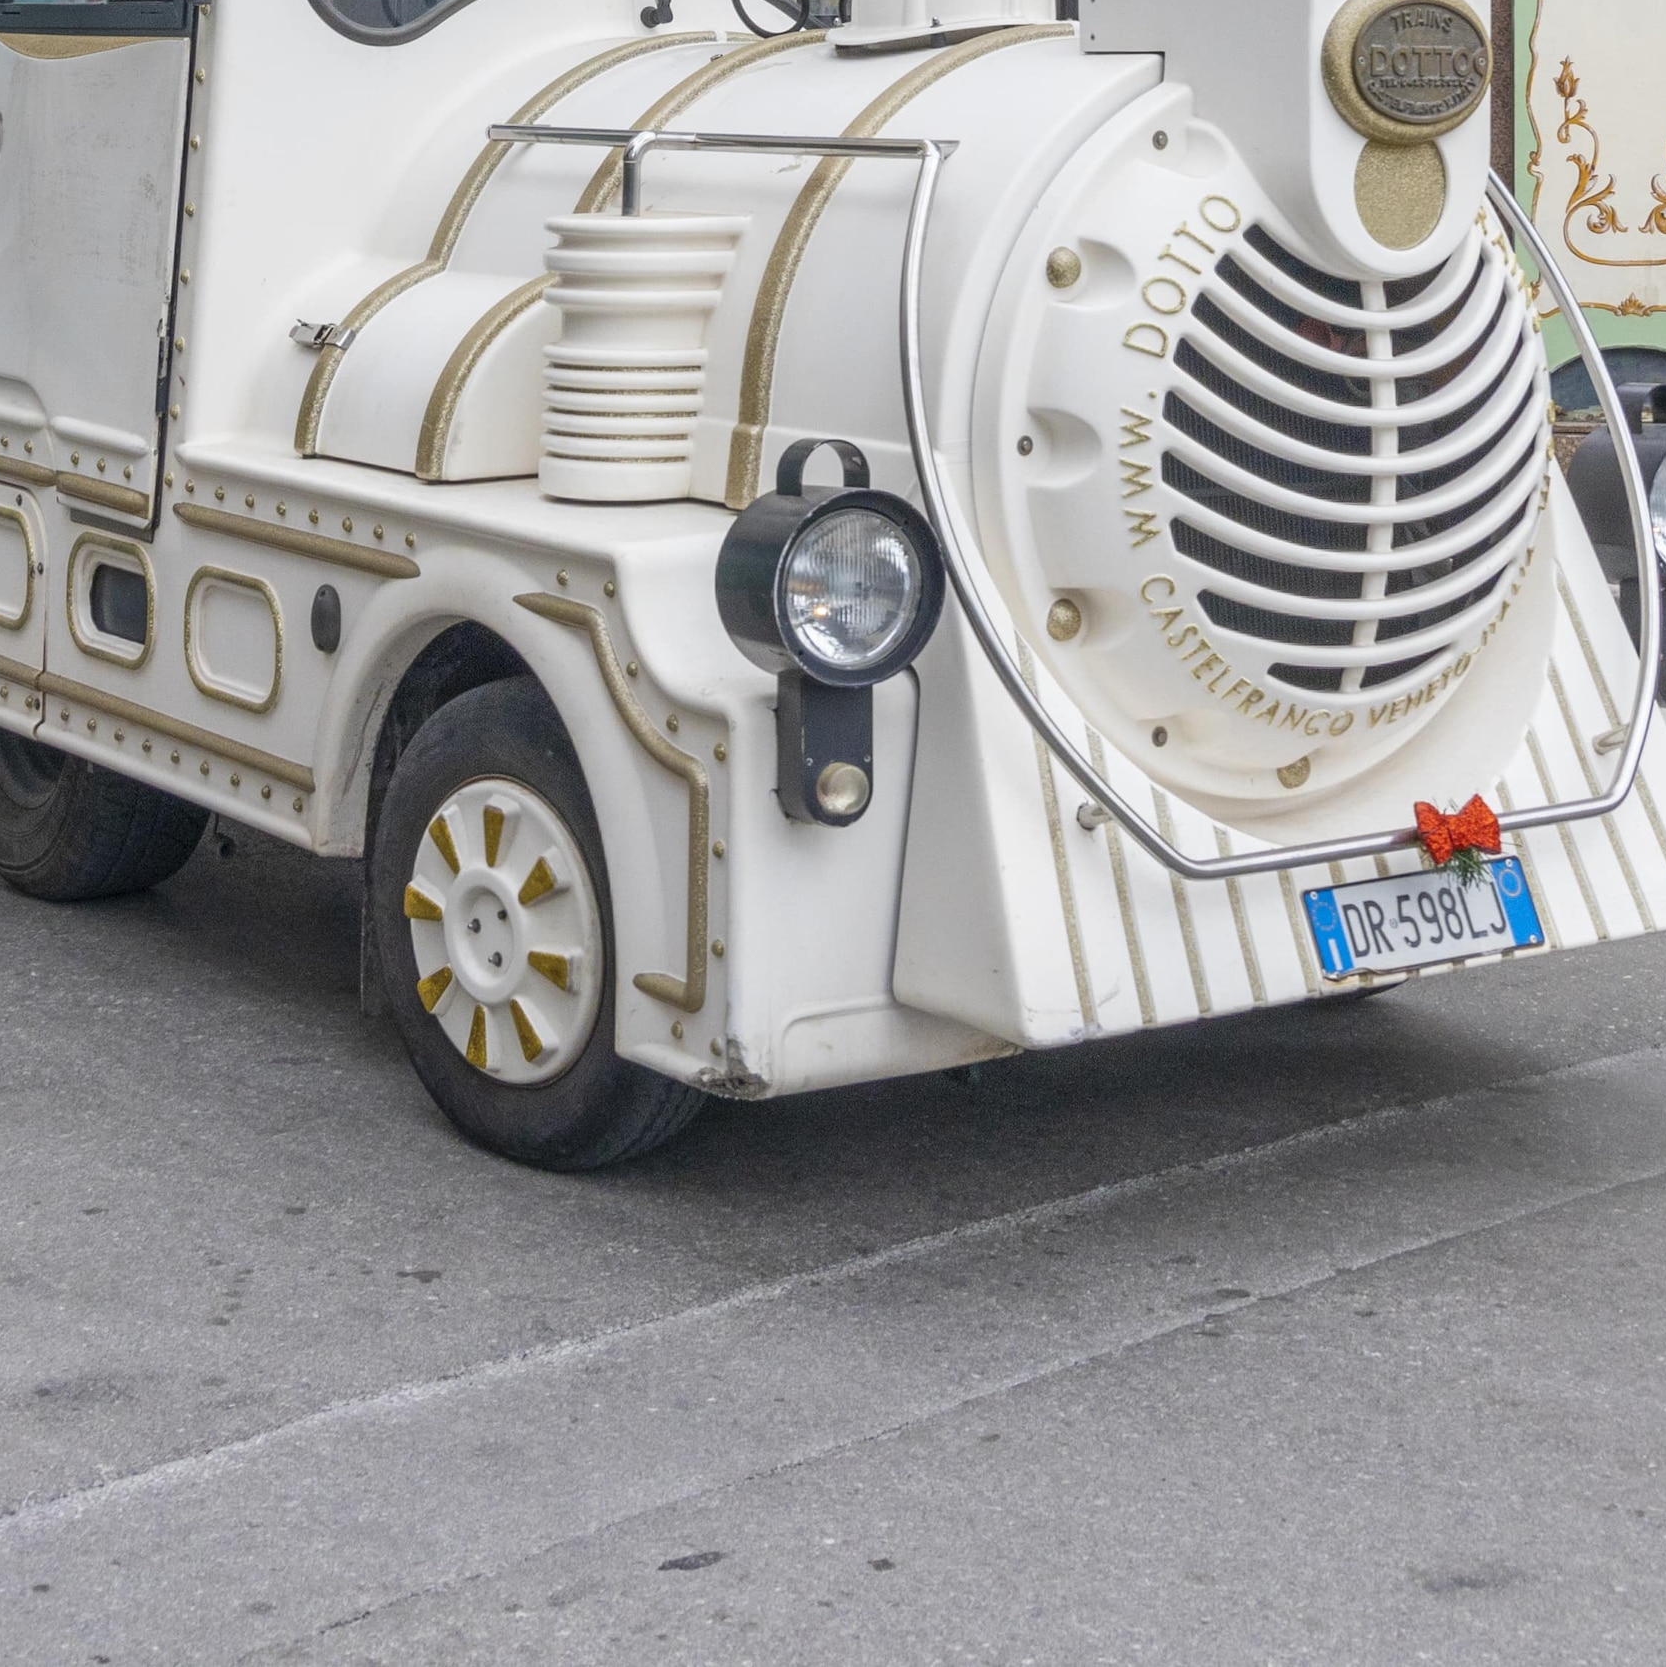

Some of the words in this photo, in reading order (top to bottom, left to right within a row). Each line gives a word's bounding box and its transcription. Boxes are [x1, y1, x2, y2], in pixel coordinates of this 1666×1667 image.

[1390, 7, 1453, 33] TRAINS
[1369, 44, 1472, 78] DOTTO
[1139, 573, 1345, 737] CASTELFRANCO
